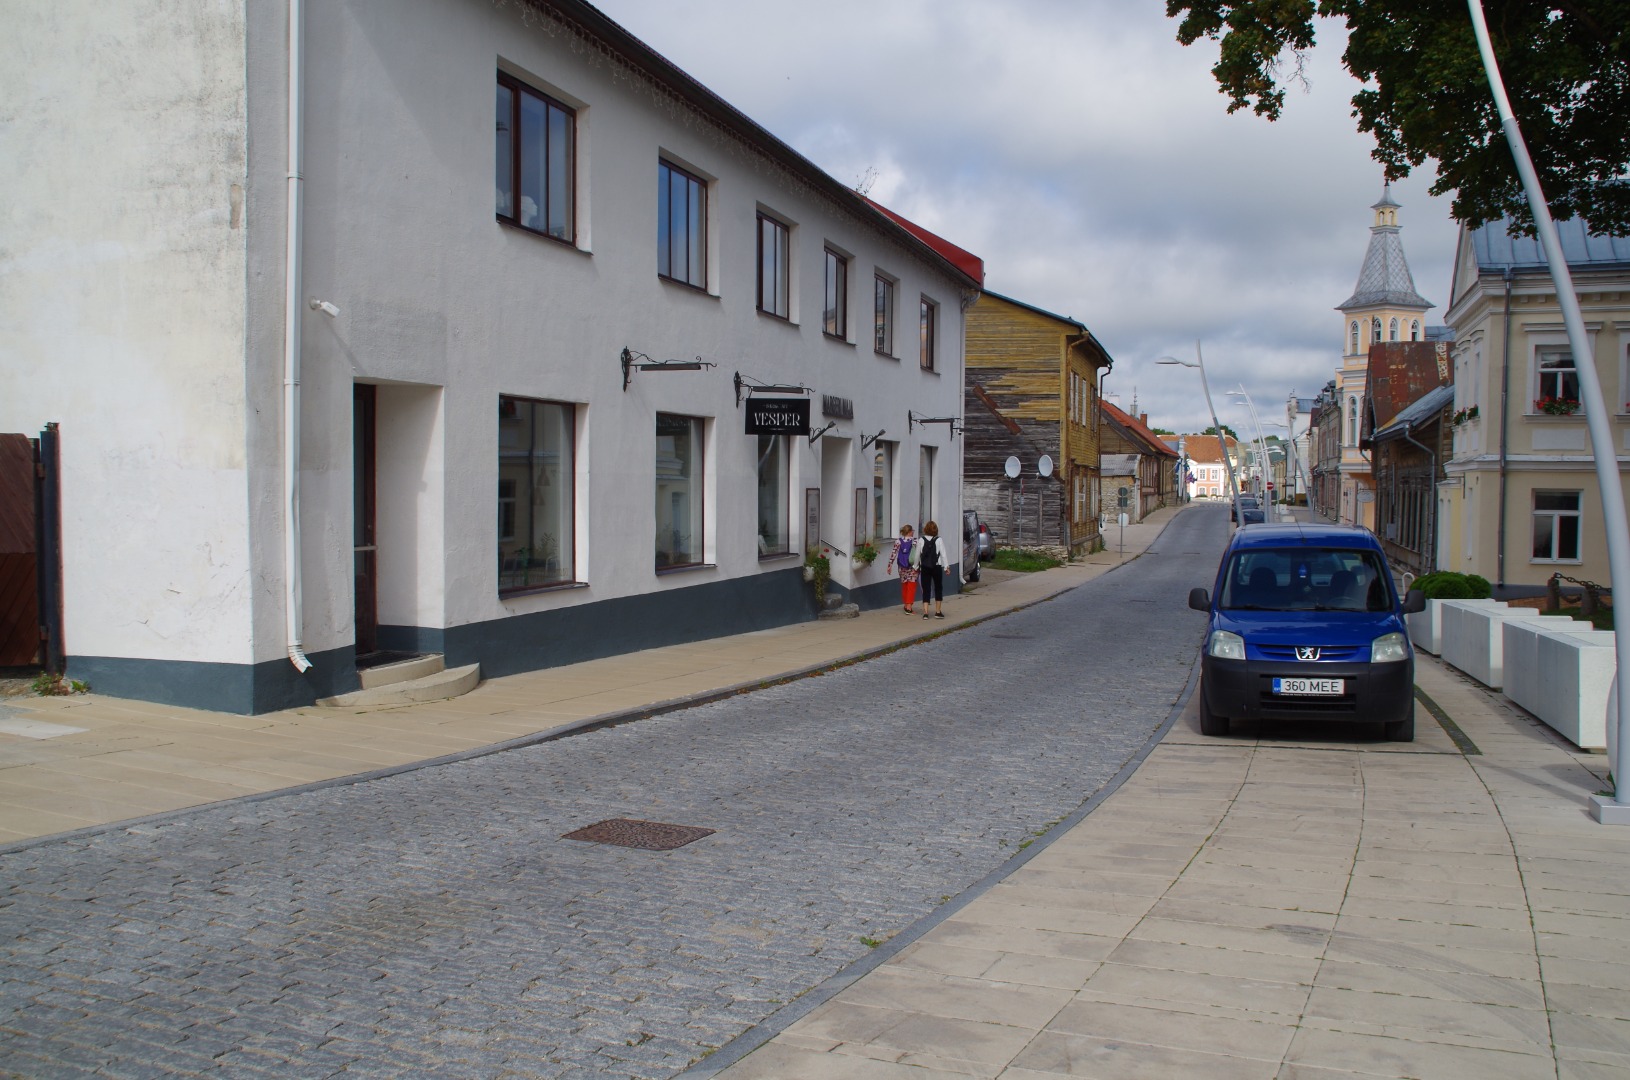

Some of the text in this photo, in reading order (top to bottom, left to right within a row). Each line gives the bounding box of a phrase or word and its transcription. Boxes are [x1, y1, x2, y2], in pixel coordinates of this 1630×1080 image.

[754, 412, 800, 426] VESPER
[1284, 680, 1340, 692] 360 MEE
